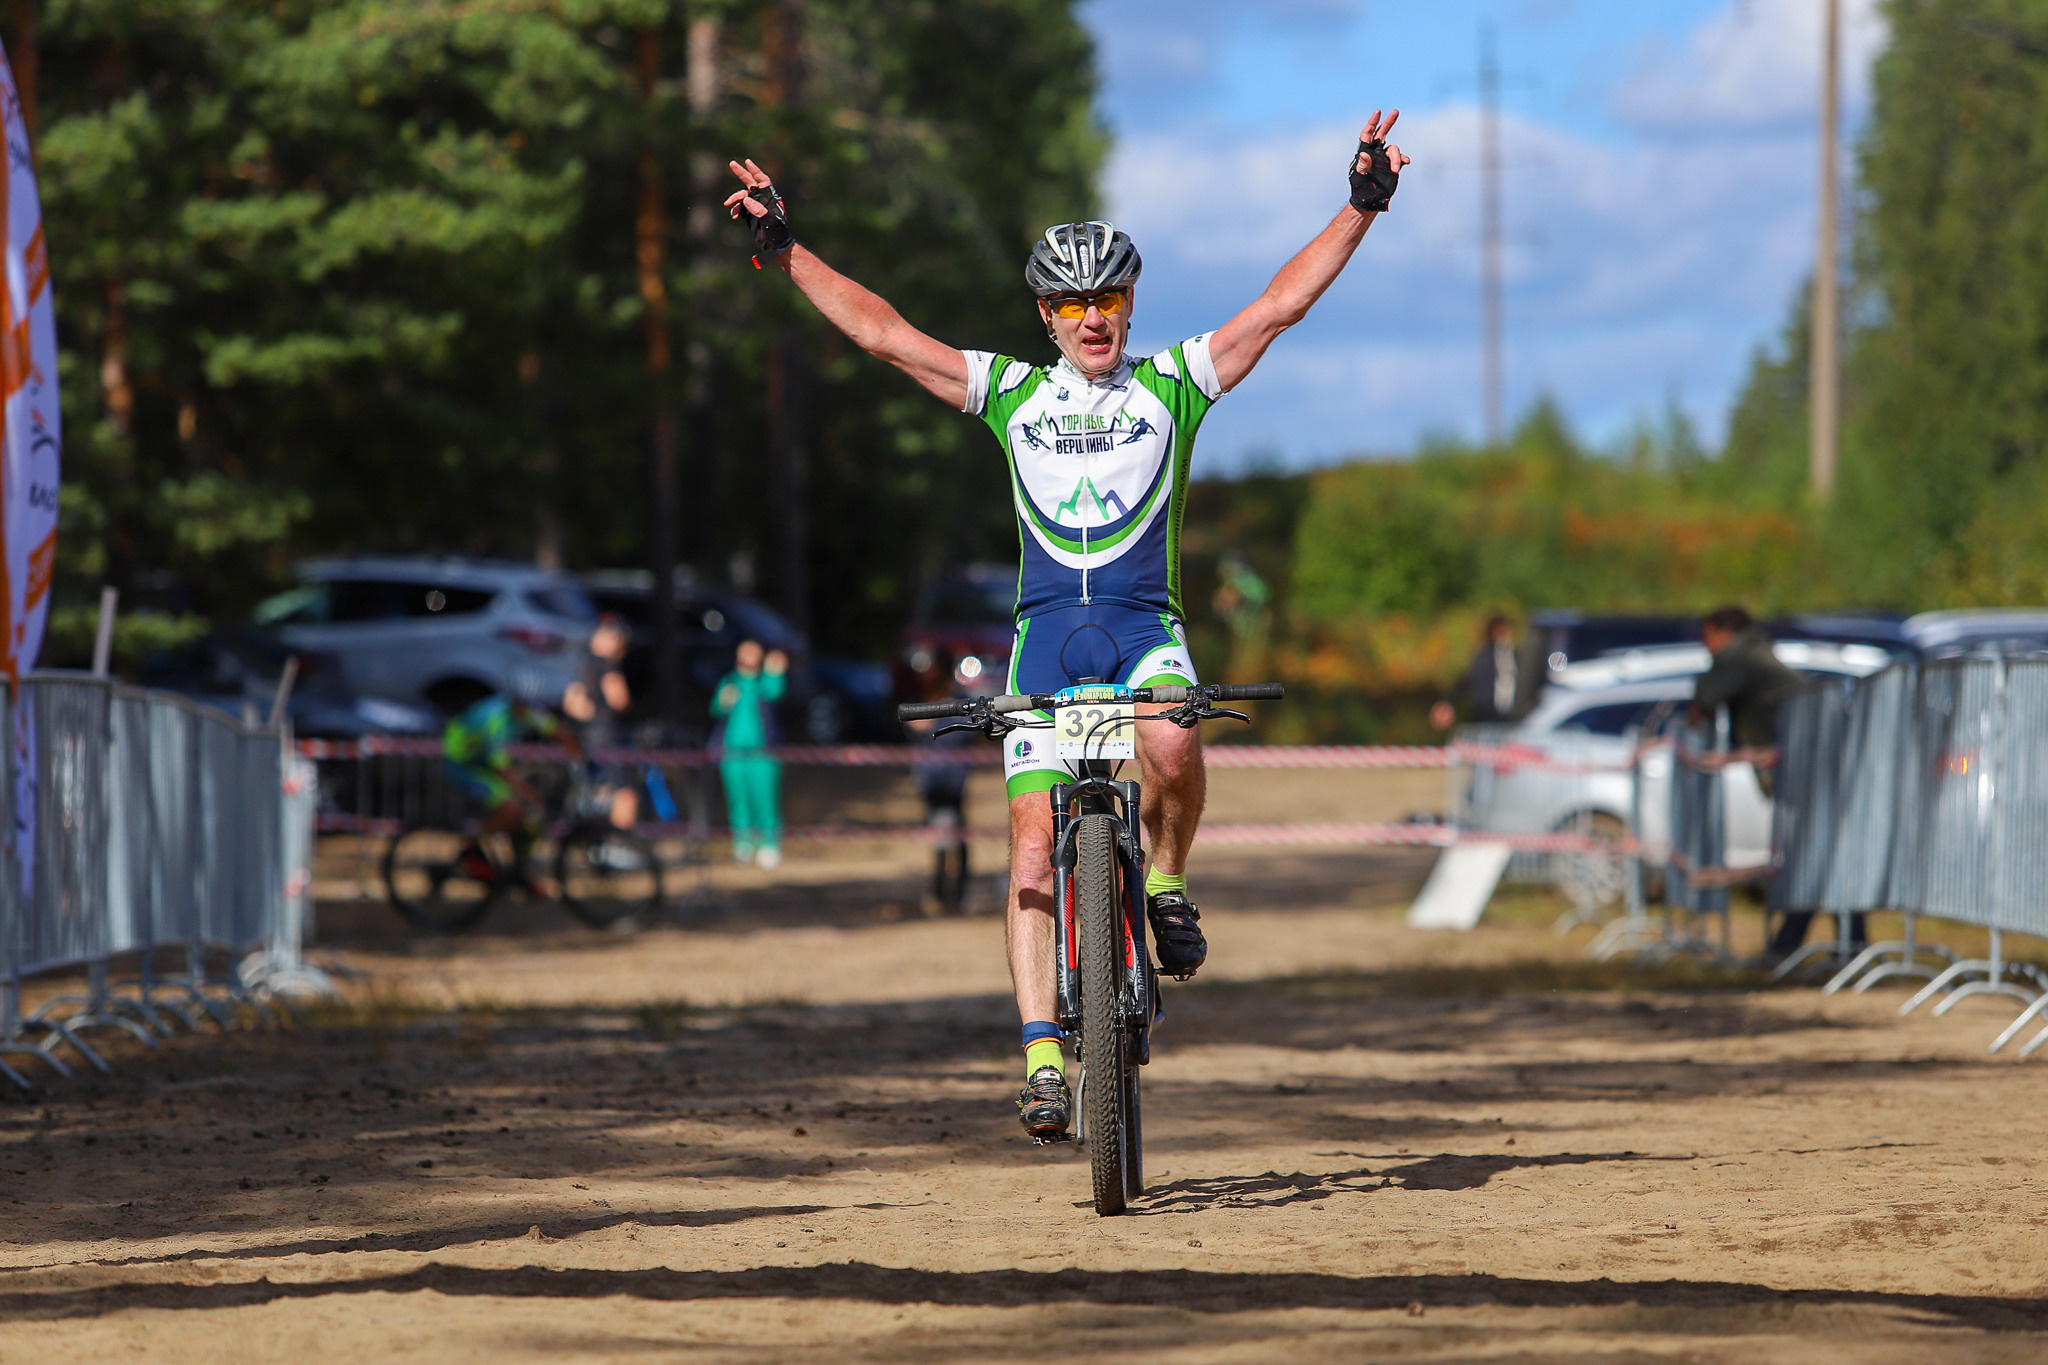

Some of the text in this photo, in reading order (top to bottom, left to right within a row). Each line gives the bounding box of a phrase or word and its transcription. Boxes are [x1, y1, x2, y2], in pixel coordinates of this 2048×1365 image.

[1061, 413, 1107, 431] ГОРНЫЕ
[1055, 435, 1114, 455] ВЕРШИНЫ
[1065, 708, 1121, 738] 321
[1011, 758, 1040, 768] МЕГАФОН
